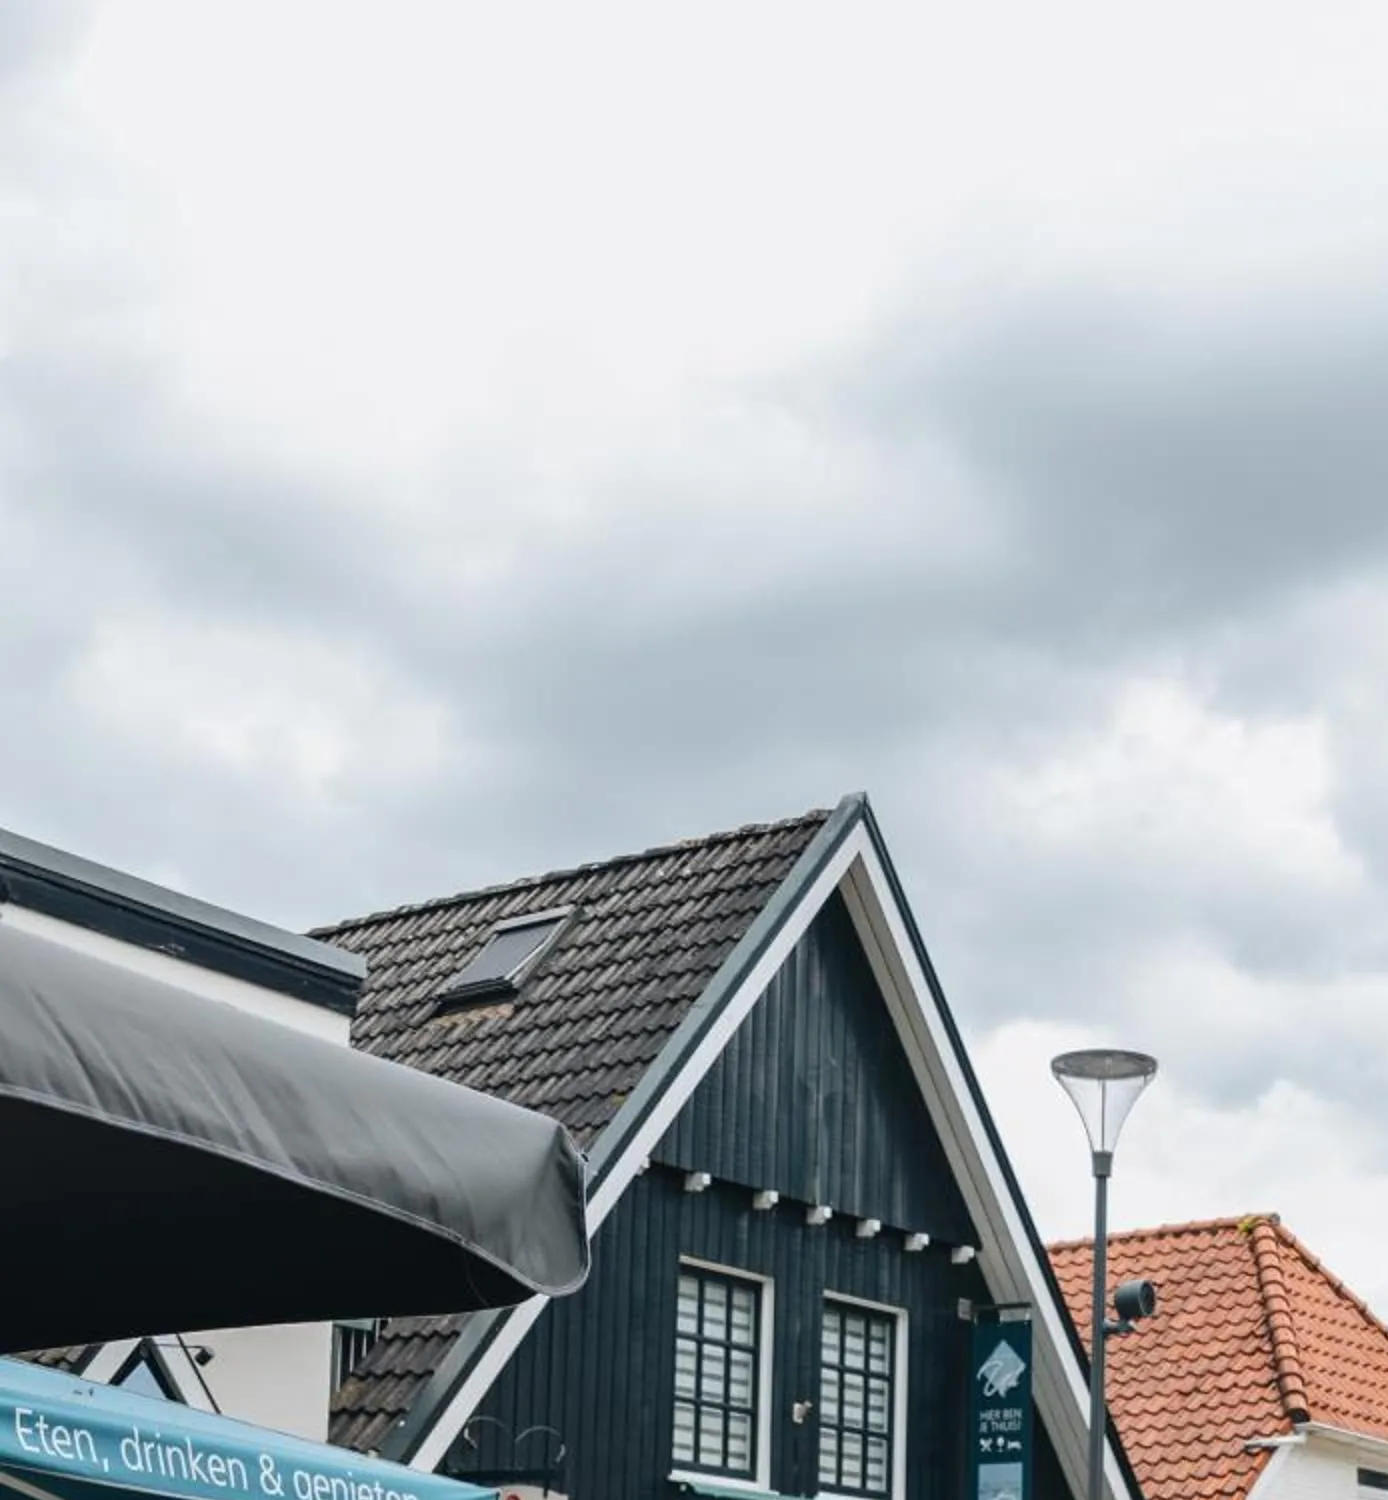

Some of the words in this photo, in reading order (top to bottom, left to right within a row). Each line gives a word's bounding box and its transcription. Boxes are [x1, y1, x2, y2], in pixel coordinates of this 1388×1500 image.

[14, 1407, 110, 1473] Eten,
[121, 1427, 249, 1491] drinken
[259, 1454, 285, 1498] &
